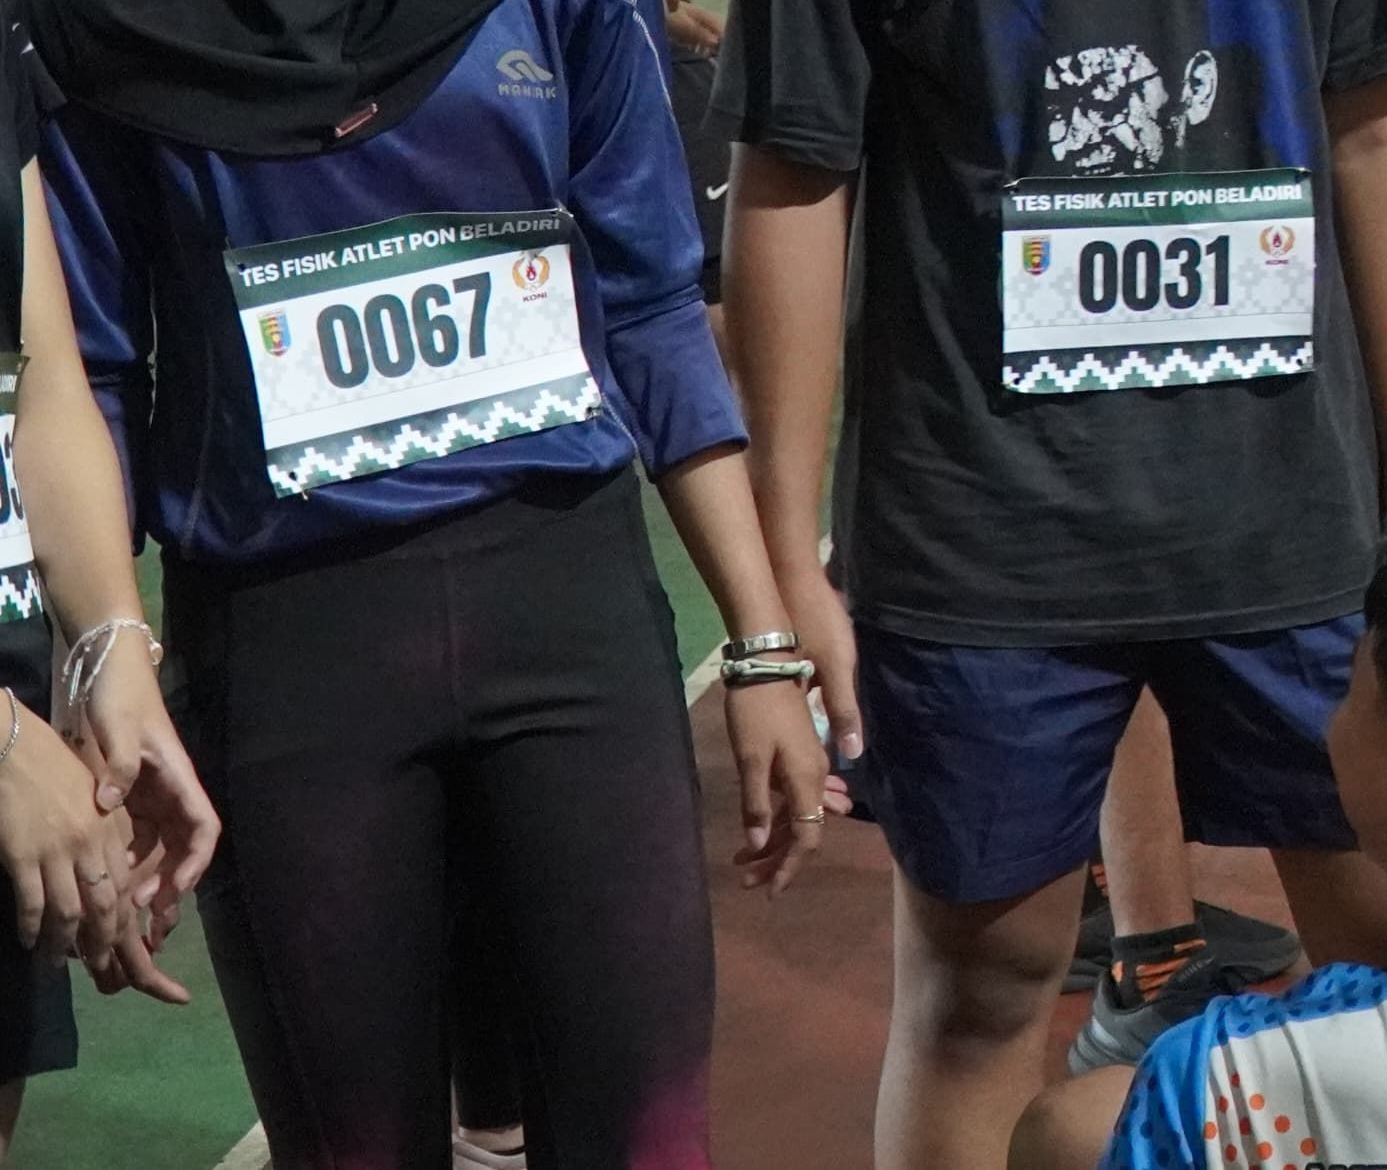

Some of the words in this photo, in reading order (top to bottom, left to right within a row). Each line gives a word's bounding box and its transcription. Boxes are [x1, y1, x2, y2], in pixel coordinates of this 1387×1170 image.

[1012, 194, 1052, 212] TES
[1054, 192, 1105, 210] FISIK
[1107, 190, 1168, 209] ATLET
[1171, 188, 1212, 206] PON
[1215, 184, 1302, 203] BELADIRI
[239, 263, 280, 287] TES
[282, 250, 338, 279] FISIK
[340, 237, 404, 265] ATLET
[410, 226, 455, 251] PON
[459, 217, 560, 241] BELADIRI
[1078, 234, 1230, 314] 0031
[316, 271, 492, 389] 0067
[522, 292, 549, 303] KONI
